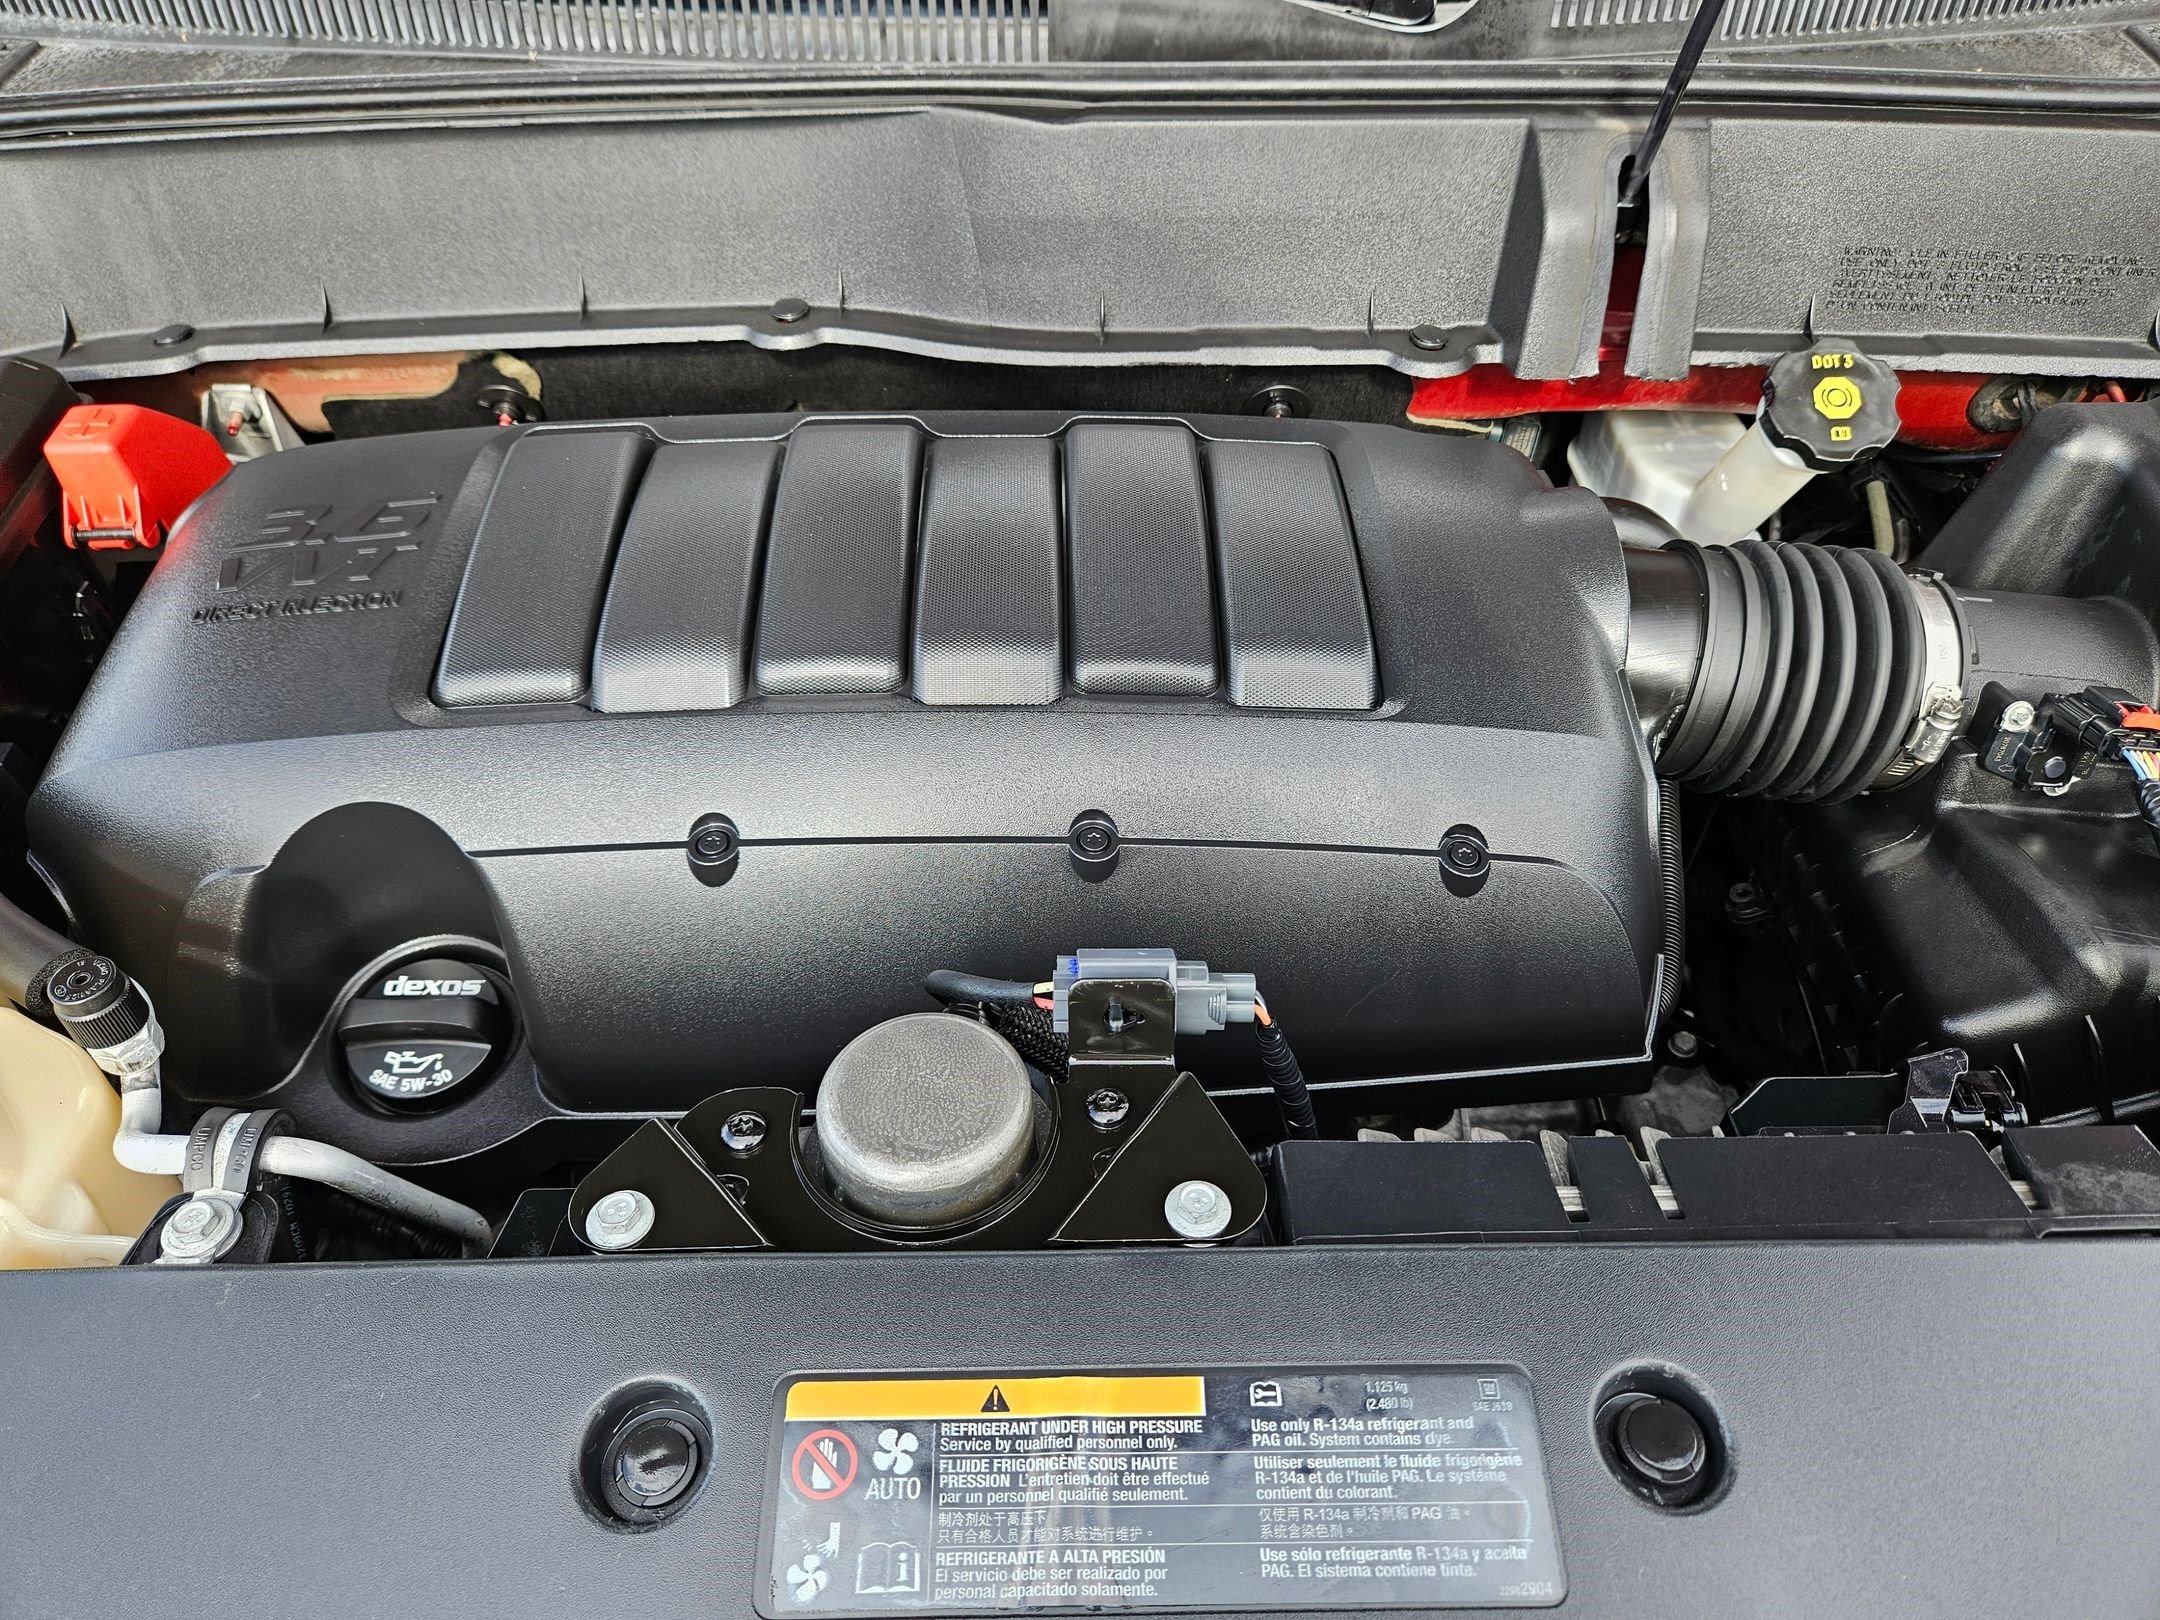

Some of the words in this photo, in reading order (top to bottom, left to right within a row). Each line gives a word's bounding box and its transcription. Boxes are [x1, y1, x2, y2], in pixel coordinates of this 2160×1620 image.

[1811, 354, 1841, 370] DOT
[1843, 354, 1854, 369] 3
[192, 598, 278, 625] DIRECT
[279, 590, 402, 617] INJECTION
[383, 975, 487, 996] dexos
[368, 1069, 400, 1091] SAE
[400, 1069, 453, 1092] 5W-30
[191, 1127, 212, 1172] UMPCO
[1364, 1381, 1393, 1394] 1.125
[941, 1421, 1038, 1436] REFRIGERANT
[1041, 1420, 1088, 1434] UNDER
[1092, 1420, 1126, 1434] HIGH
[1129, 1420, 1202, 1434] PRESSURE
[1251, 1419, 1276, 1432] Use
[1283, 1418, 1310, 1434] only
[1313, 1418, 1364, 1431] R-134a
[1367, 1417, 1444, 1434] refrigerant
[1448, 1416, 1474, 1430] and
[940, 1437, 991, 1452] Service
[995, 1437, 1011, 1453] by
[1015, 1435, 1073, 1453] qualified
[1076, 1435, 1143, 1451] personnel
[1146, 1435, 1178, 1451] only.
[1252, 1433, 1280, 1447] PAG
[1284, 1433, 1306, 1446] oil.
[1309, 1432, 1360, 1448] System
[1364, 1432, 1421, 1446] contains
[1424, 1432, 1455, 1446] dye.
[939, 1459, 990, 1472] FLUIDE
[993, 1454, 1086, 1472] FRIGORIGÈNE
[1089, 1457, 1128, 1470] SOUS
[1131, 1456, 1178, 1470] HAUTE
[1254, 1456, 1302, 1469] Utiliser
[1307, 1455, 1381, 1469] seulement
[1384, 1455, 1396, 1468] le
[1400, 1454, 1441, 1468] fluide
[939, 1474, 1010, 1488] PRESSION
[1019, 1473, 1090, 1487] L'entretien
[1092, 1472, 1119, 1485] doit
[1122, 1472, 1150, 1485] être
[1152, 1471, 1209, 1485] effectué
[1255, 1470, 1304, 1484] R-134a
[1308, 1472, 1323, 1484] et
[1326, 1470, 1343, 1483] de
[1347, 1470, 1388, 1483] l'huile
[1392, 1470, 1424, 1482] PAG.
[1427, 1470, 1446, 1482] Le
[1448, 1470, 1506, 1485] système
[864, 1477, 921, 1500] AUTO
[939, 1491, 962, 1505] par
[965, 1491, 984, 1504] un
[987, 1489, 1057, 1505] personnel
[1059, 1488, 1109, 1503] qualifié
[1112, 1487, 1188, 1501] seulement.
[1256, 1486, 1312, 1500] contient
[1316, 1486, 1333, 1499] du
[1336, 1486, 1398, 1498] colorant.
[938, 1510, 1047, 1527] 制冷剂处于高压下
[1258, 1507, 1300, 1521] 仅使用
[1303, 1508, 1349, 1520] R-134a
[1412, 1507, 1441, 1519] PAG
[1259, 1524, 1354, 1539] 系统含染色剂。
[935, 1551, 1045, 1566] REFRIGERANTE
[1049, 1550, 1062, 1563] A
[1063, 1550, 1099, 1564] ALTA
[1102, 1547, 1165, 1563] PRESIÓN
[1260, 1548, 1288, 1562] Use
[1291, 1547, 1321, 1561] sólo
[1326, 1547, 1412, 1563] refrigerante
[1416, 1547, 1469, 1560] R-134a
[1473, 1550, 1480, 1564] y
[1484, 1547, 1527, 1560] aceite
[936, 1569, 948, 1583] El
[952, 1568, 1007, 1582] servicio
[1012, 1567, 1046, 1581] debe
[1050, 1569, 1073, 1580] ser
[1076, 1567, 1141, 1580] realizado
[1145, 1568, 1168, 1582] por
[1262, 1564, 1295, 1578] PAG.
[1299, 1565, 1311, 1577] El
[1315, 1564, 1371, 1578] sistema
[1375, 1563, 1437, 1577] contiene
[1440, 1563, 1477, 1577] tinte.
[935, 1584, 995, 1604] personal
[1001, 1583, 1077, 1599] capacitado
[1081, 1583, 1158, 1597] solamente.
